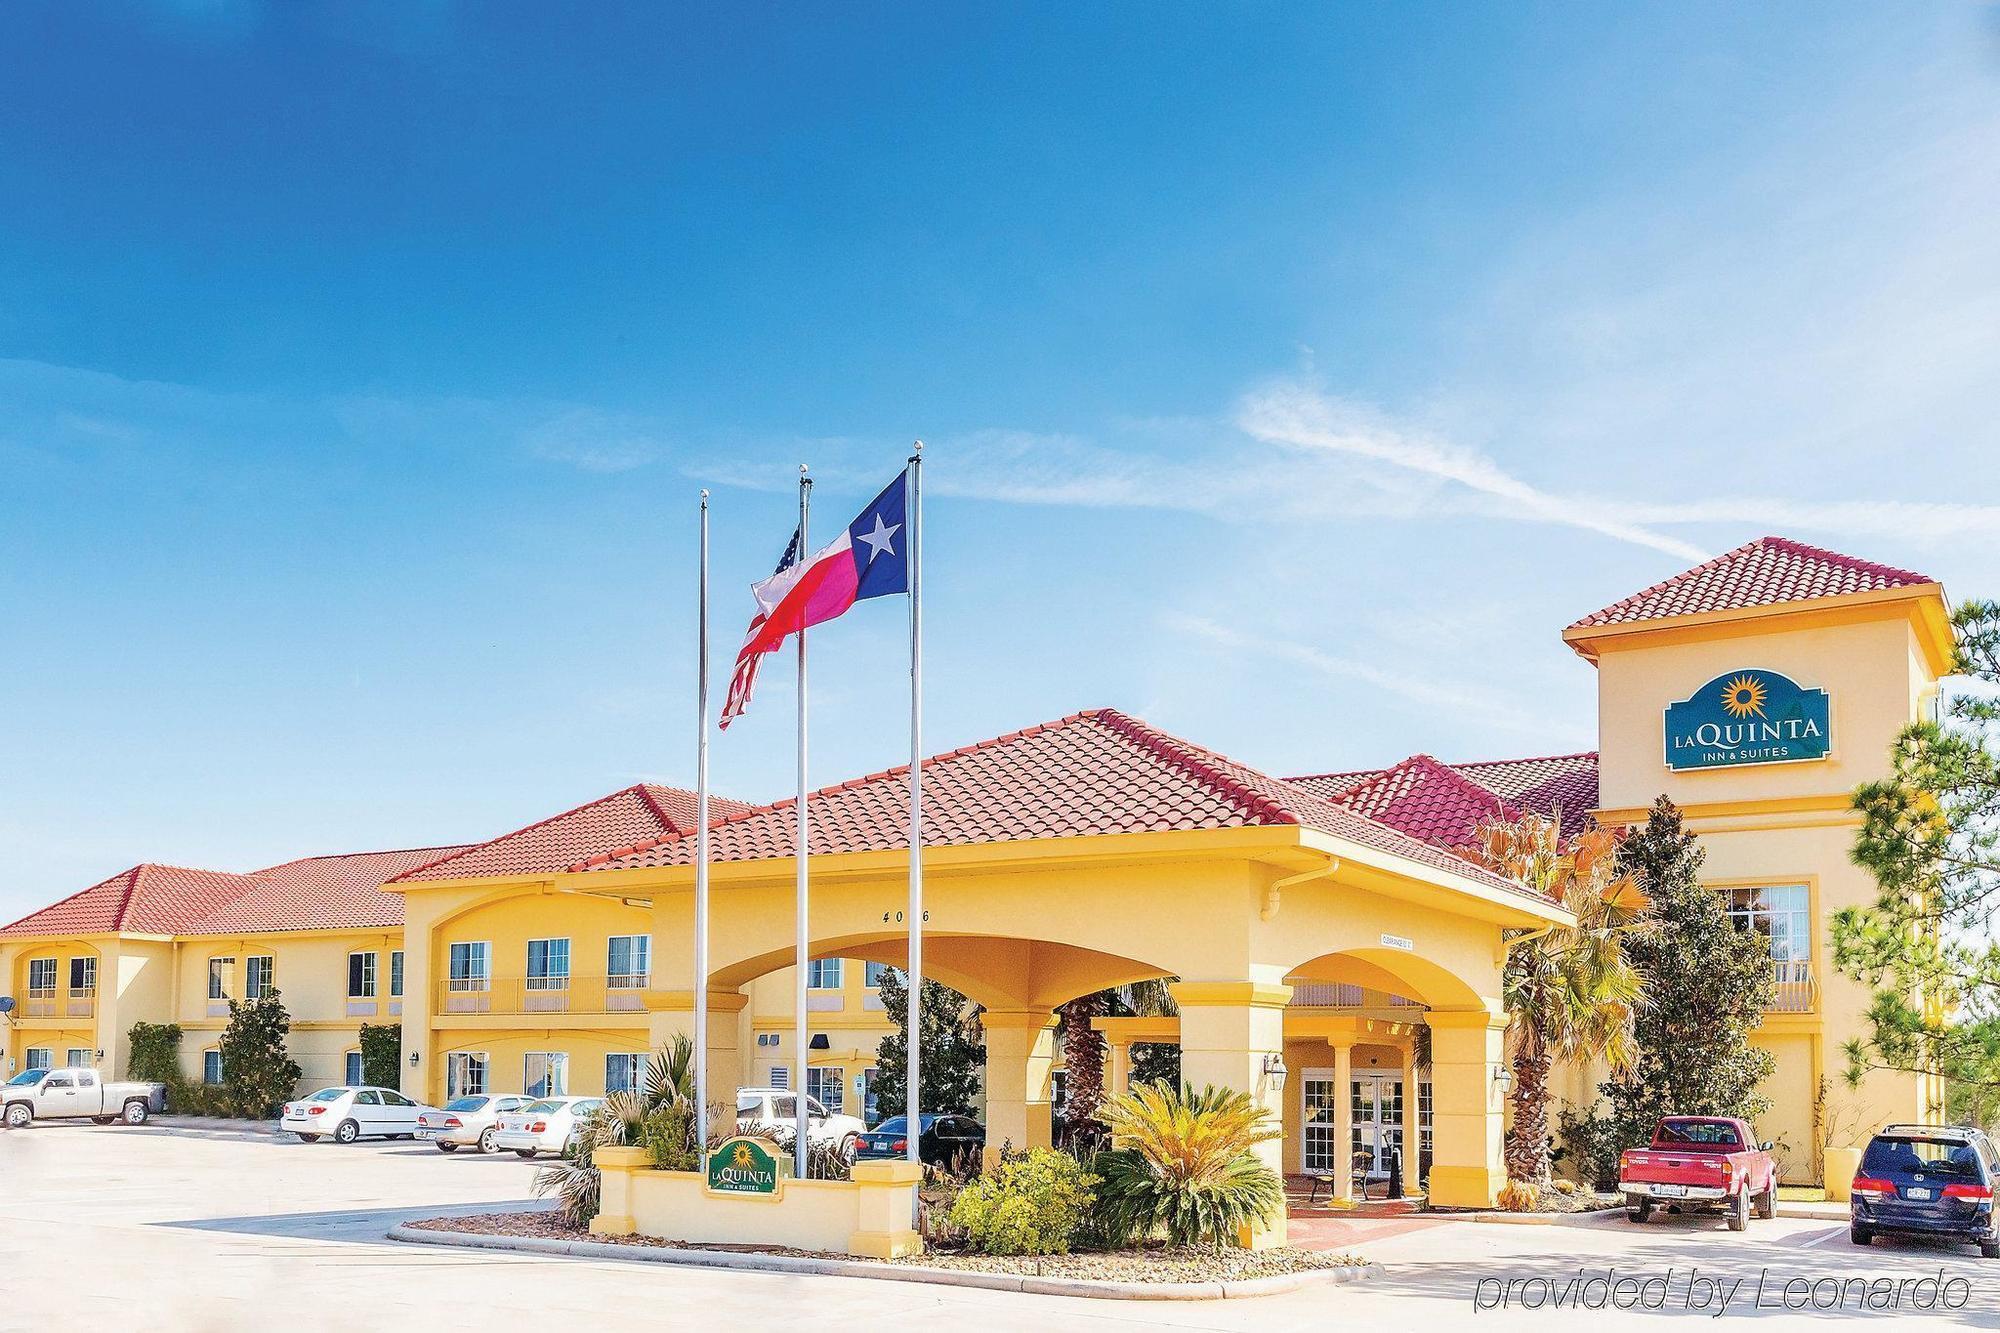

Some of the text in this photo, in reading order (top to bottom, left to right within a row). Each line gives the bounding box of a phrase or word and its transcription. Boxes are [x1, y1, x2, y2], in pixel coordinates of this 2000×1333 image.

[1675, 718, 1822, 750] LA QUINTA
[1703, 746, 1788, 762] INN & SUITES
[882, 910, 930, 923] 406
[712, 1167, 772, 1184] LA QUINTA
